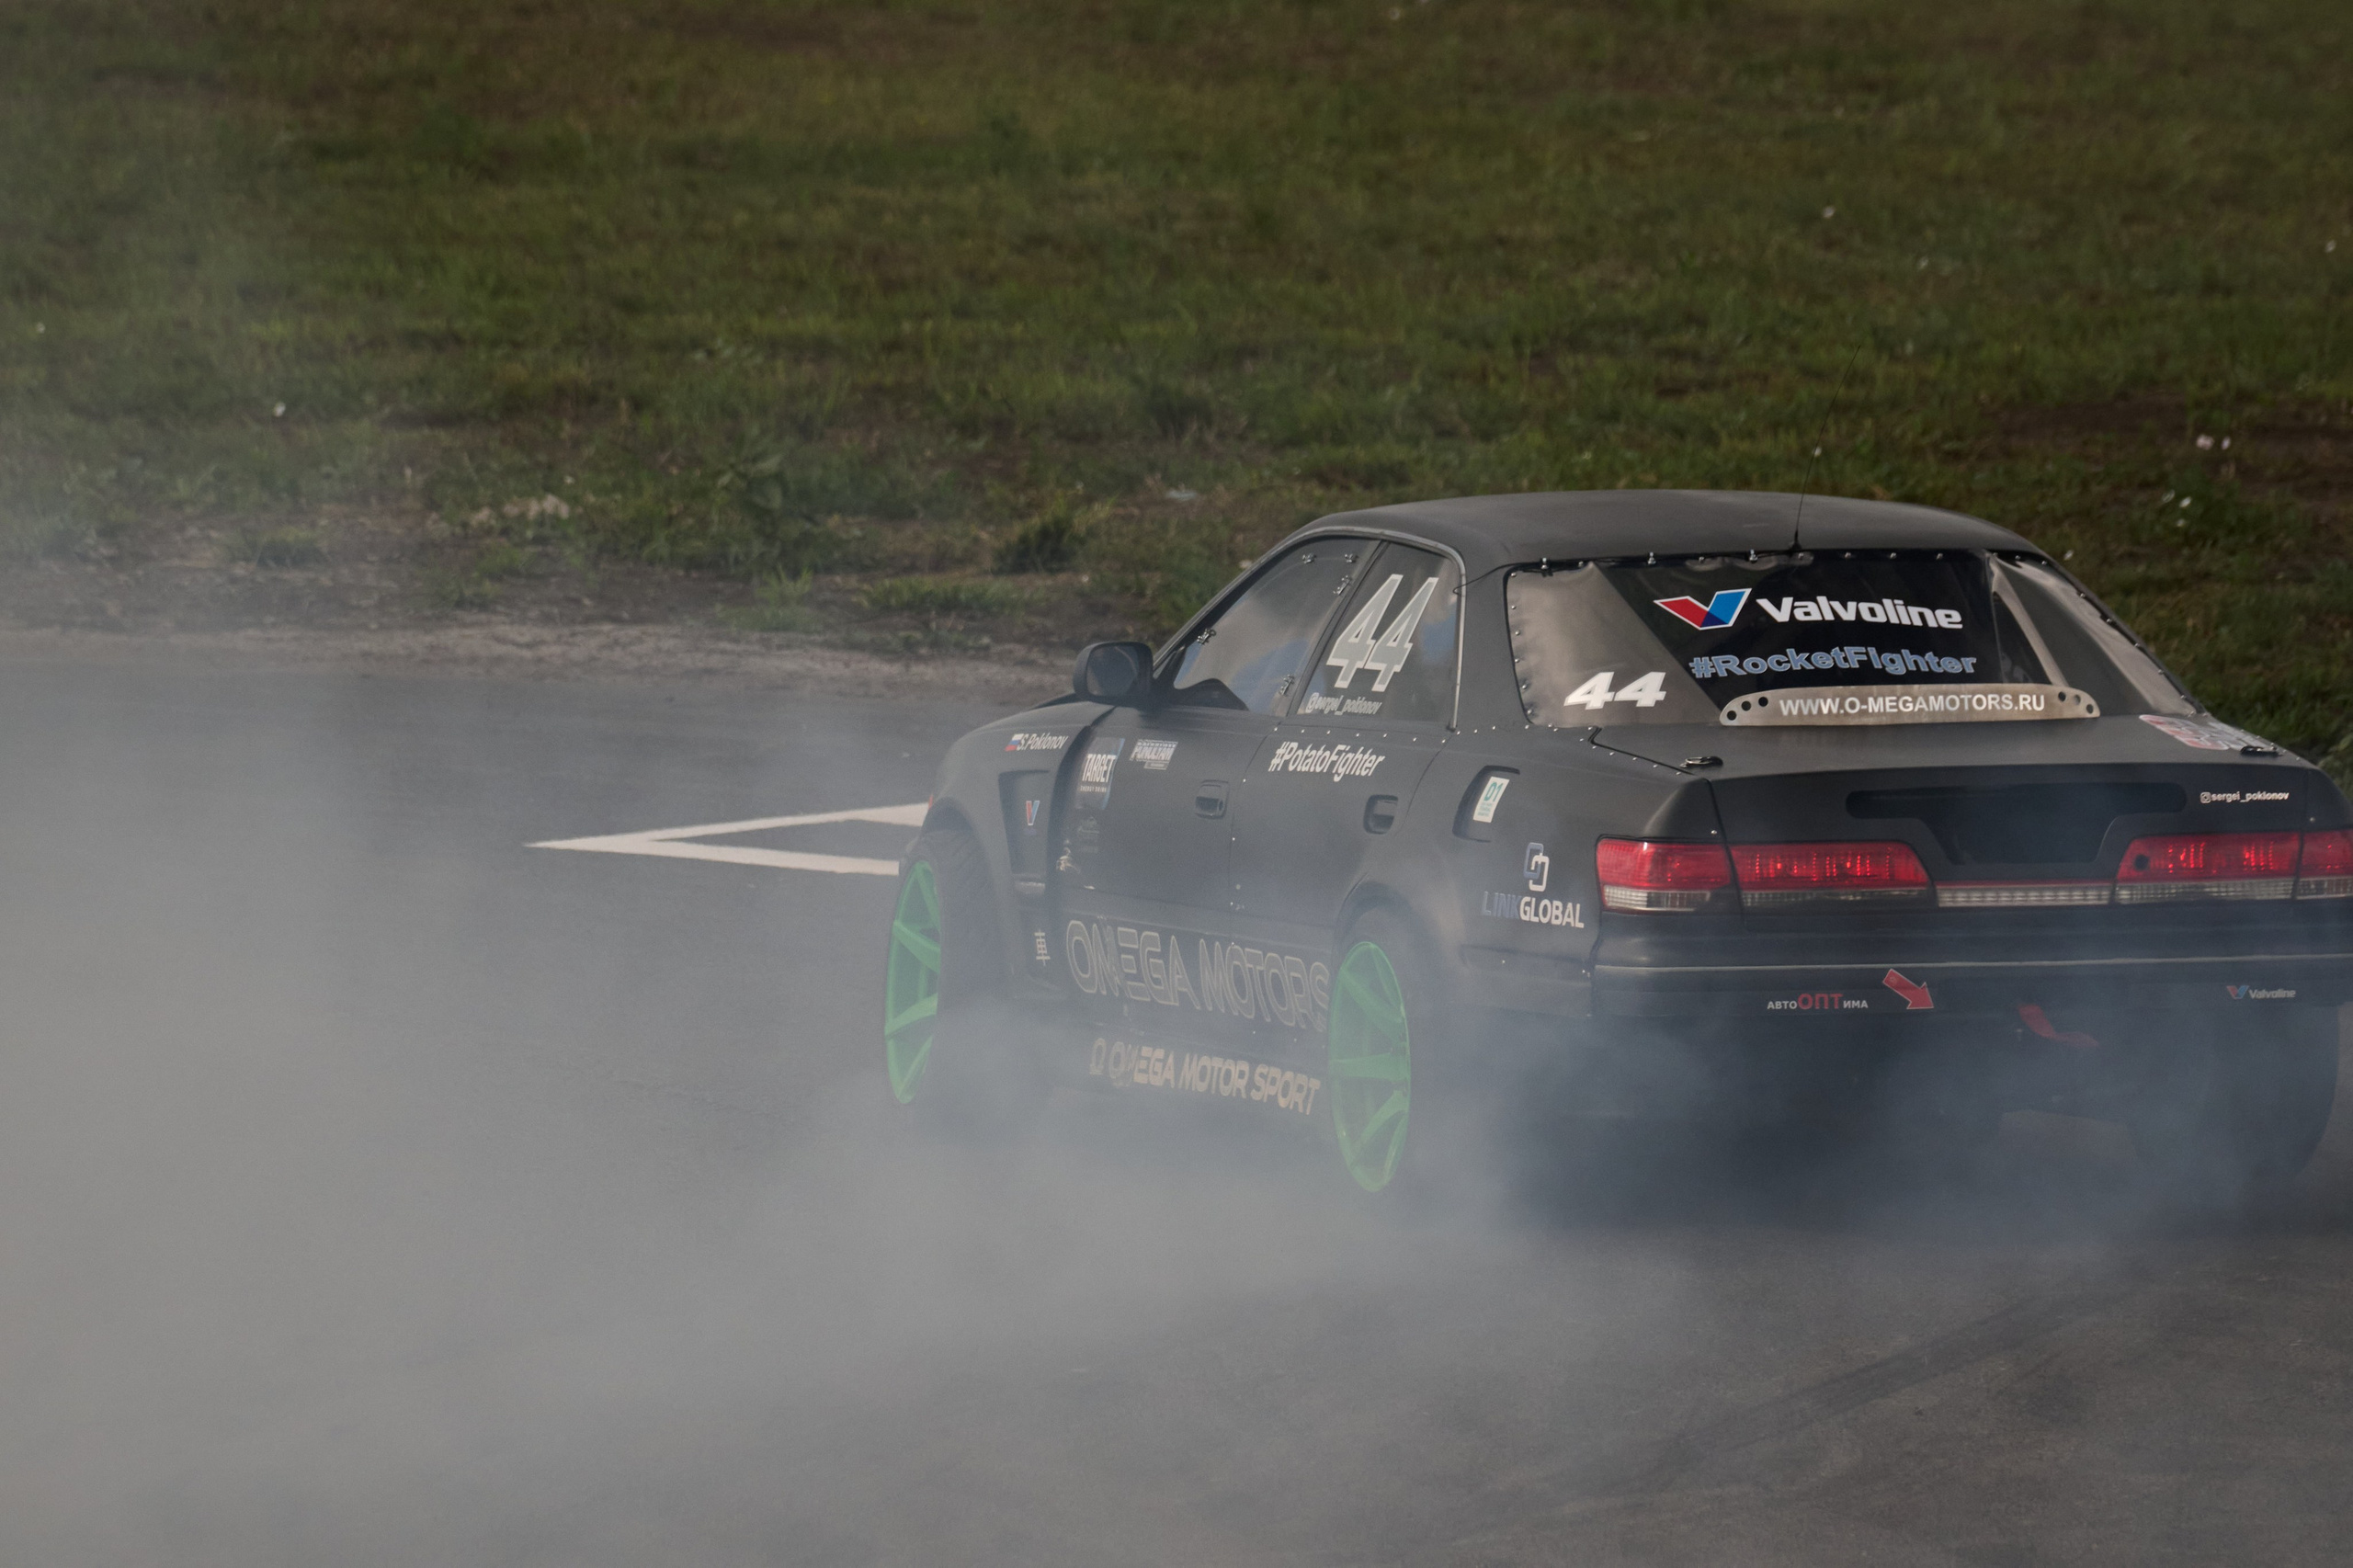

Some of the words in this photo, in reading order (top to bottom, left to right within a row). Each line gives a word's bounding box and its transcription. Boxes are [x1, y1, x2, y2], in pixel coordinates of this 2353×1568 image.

[1756, 596, 1963, 629] Valvoline
[1326, 574, 1439, 692] 44
[1564, 672, 1666, 710] 44
[1779, 694, 2045, 716] WWW.O-MEGAMOTORS.RU
[1017, 733, 1069, 751] S.Poklonov
[1082, 754, 1116, 782] TARGET
[1268, 741, 1385, 782] #PotatoFighter
[1199, 938, 1331, 1033] MOTORS
[2248, 989, 2296, 999] Valvoline
[1178, 1052, 1250, 1099] MOTOR
[1250, 1063, 1321, 1116] SPORT
